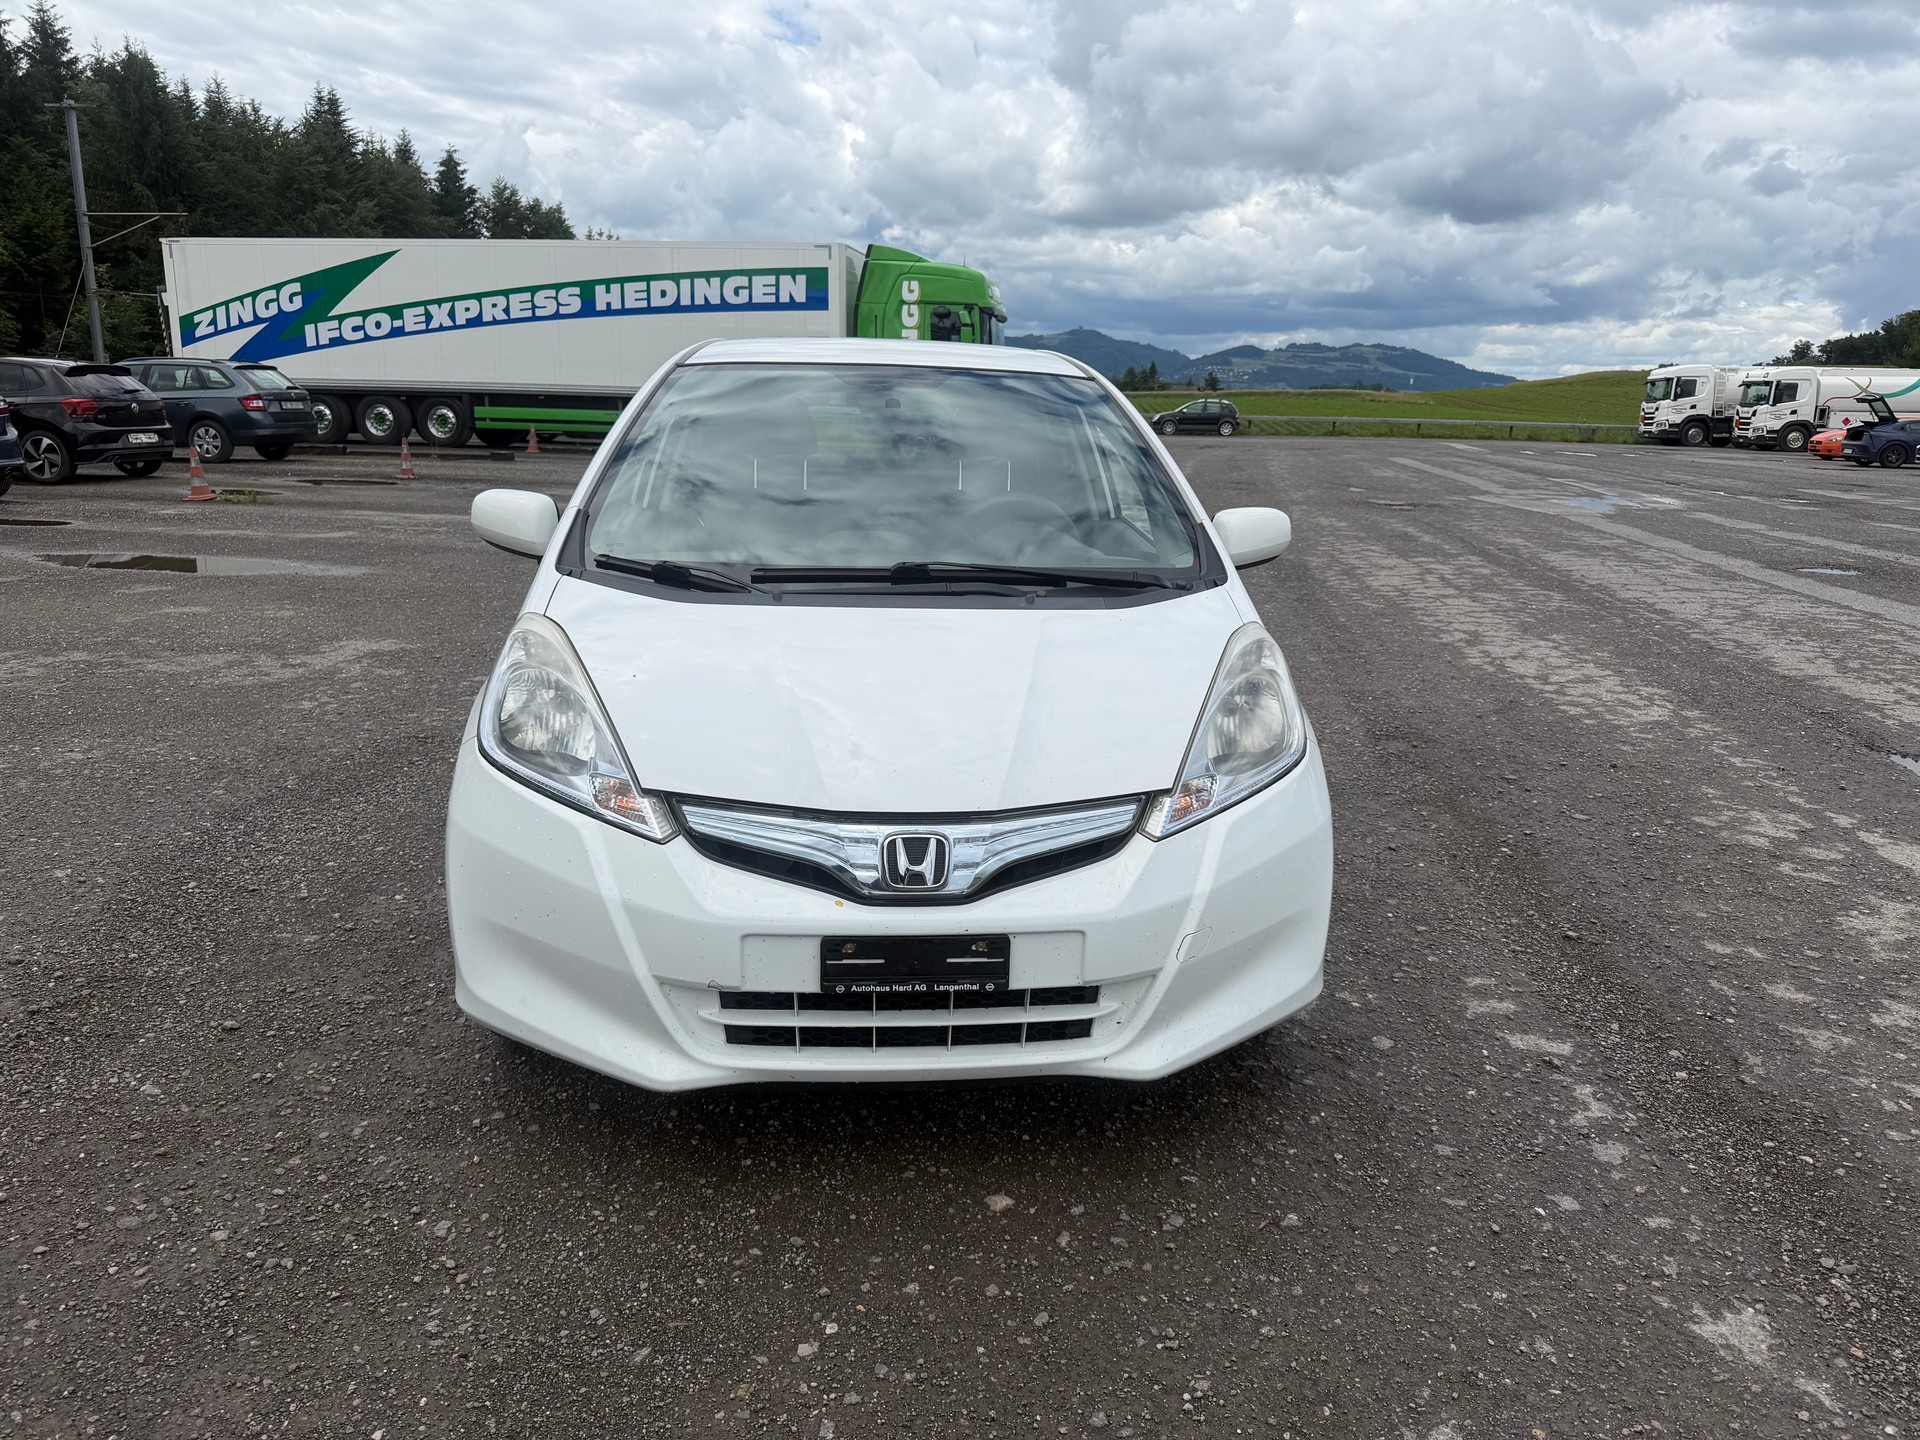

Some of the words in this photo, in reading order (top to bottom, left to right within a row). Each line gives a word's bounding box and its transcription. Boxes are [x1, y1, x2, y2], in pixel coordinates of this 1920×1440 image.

[194, 283, 303, 339] ZINGG
[305, 287, 582, 347] IFCO-EXPRESS
[595, 274, 807, 310] HEDINGEN
[851, 984, 890, 992] Autohaus
[892, 984, 912, 992] Hard
[914, 984, 927, 992] AG
[934, 983, 979, 993] Langenthal
